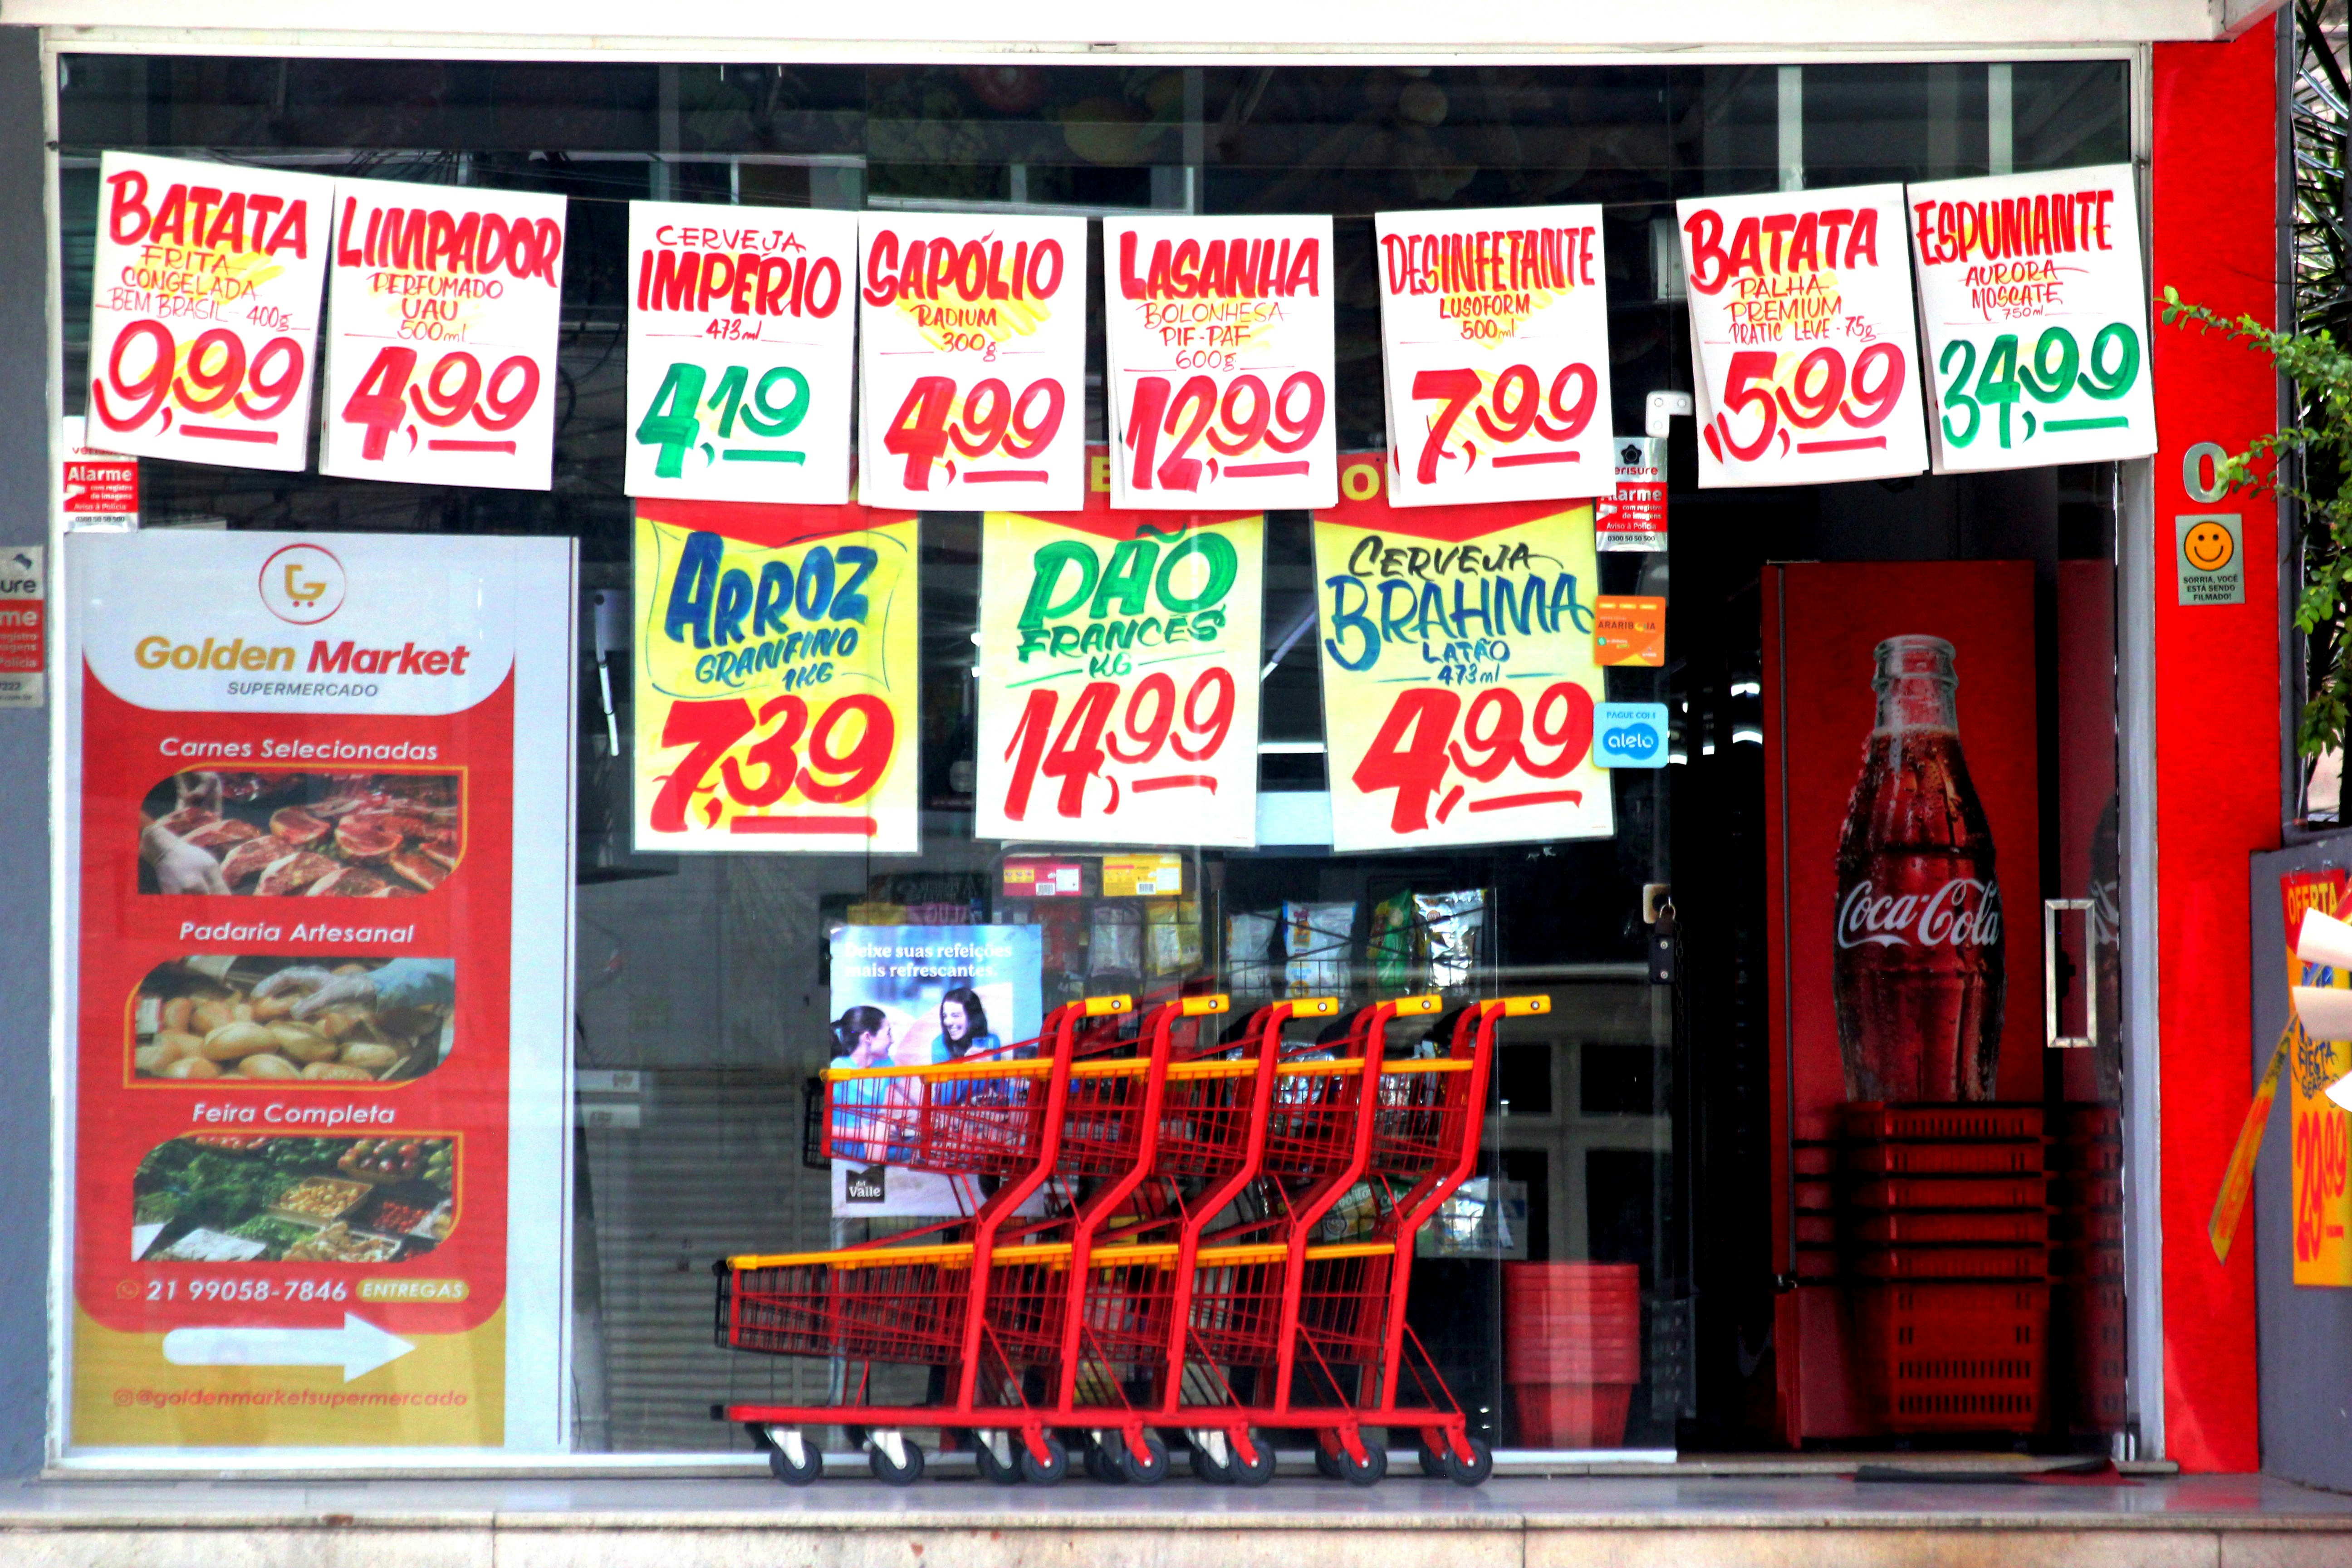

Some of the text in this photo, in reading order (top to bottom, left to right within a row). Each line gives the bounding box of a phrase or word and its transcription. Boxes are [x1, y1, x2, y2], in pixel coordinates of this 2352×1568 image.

[107, 170, 307, 260] BATATA
[1913, 189, 2114, 266] ESPUMANTE
[337, 196, 562, 289] LIMPADOR
[656, 225, 806, 253] CERVEJA
[1684, 207, 1879, 296] BATATA
[142, 245, 238, 273] FRITA
[862, 228, 1064, 308] SAPÓLIO
[1120, 230, 1320, 301] LASANHA
[1381, 226, 1596, 296] DESINFETANTE
[122, 266, 258, 300] CONGELADA
[372, 272, 504, 300] PERFUMADO
[1732, 273, 1828, 299] PALHA
[1957, 263, 2069, 285] AURORA
[109, 287, 293, 331] BEM BRASIL 400g
[401, 298, 458, 322] UAU
[1439, 297, 1530, 319] LUSOFORM
[1724, 296, 1842, 324] PREMIUM
[1972, 282, 2064, 318] MOSCATE
[2002, 305, 2043, 319] 750ml
[910, 304, 997, 328] RADIUM
[1143, 301, 1284, 330] BOLONHESA
[1460, 318, 1517, 340] 500ml
[1729, 314, 1881, 345] PRATIC LEVE 75g
[397, 320, 467, 344] 500ml
[706, 319, 762, 341] 473ml
[1162, 323, 1252, 347] PIF-PAF
[941, 333, 998, 362] 300g
[1175, 348, 1236, 371] 600g
[92, 319, 304, 437] 9,99
[1939, 322, 2141, 450] 34,99
[341, 346, 540, 462] 4,99
[1716, 341, 1906, 463] 5,99
[636, 362, 810, 479] 4,19
[883, 375, 1065, 491] 4,99
[1125, 370, 1326, 493] 12,99
[1411, 362, 1598, 485] 7,99
[69, 466, 132, 481] Alarme
[1615, 466, 1658, 475] erisure
[1633, 512, 1662, 521] imagens
[1637, 505, 1662, 513] registro
[1633, 522, 1656, 530] Polícia
[1348, 534, 1564, 582] CERVEJA
[663, 530, 878, 649] ARROZ
[1017, 522, 1238, 629] PÃO
[2184, 576, 2215, 584] SORRIA,
[1325, 573, 1595, 671] BRAHMA
[134, 635, 470, 676] Golden Market
[695, 627, 859, 686] GRANFINO
[1422, 638, 1511, 664] LATÃO
[782, 662, 833, 691] 1KG
[1089, 653, 1132, 679] KG
[1437, 663, 1499, 686] 473ml
[227, 681, 379, 698] SUPERMERCADO
[159, 737, 438, 761] Carnes Selecionadas
[1004, 666, 1236, 822] 14,99
[1608, 733, 1654, 748] alelo
[649, 693, 895, 833] 7,39
[1352, 681, 1595, 834] 4,99
[1838, 878, 1999, 950] Coca-Cola
[179, 921, 415, 944] Padaria Artesanal
[845, 942, 1012, 962] Deixe suas refeições
[845, 963, 998, 978] mais refrescantes.
[192, 1102, 395, 1127] Feira Completa
[849, 1185, 881, 1198] Valle
[147, 1280, 464, 1301] 21 99058-7846 ENTREGAS
[135, 1389, 467, 1409] @goldenmarketsupermercado
